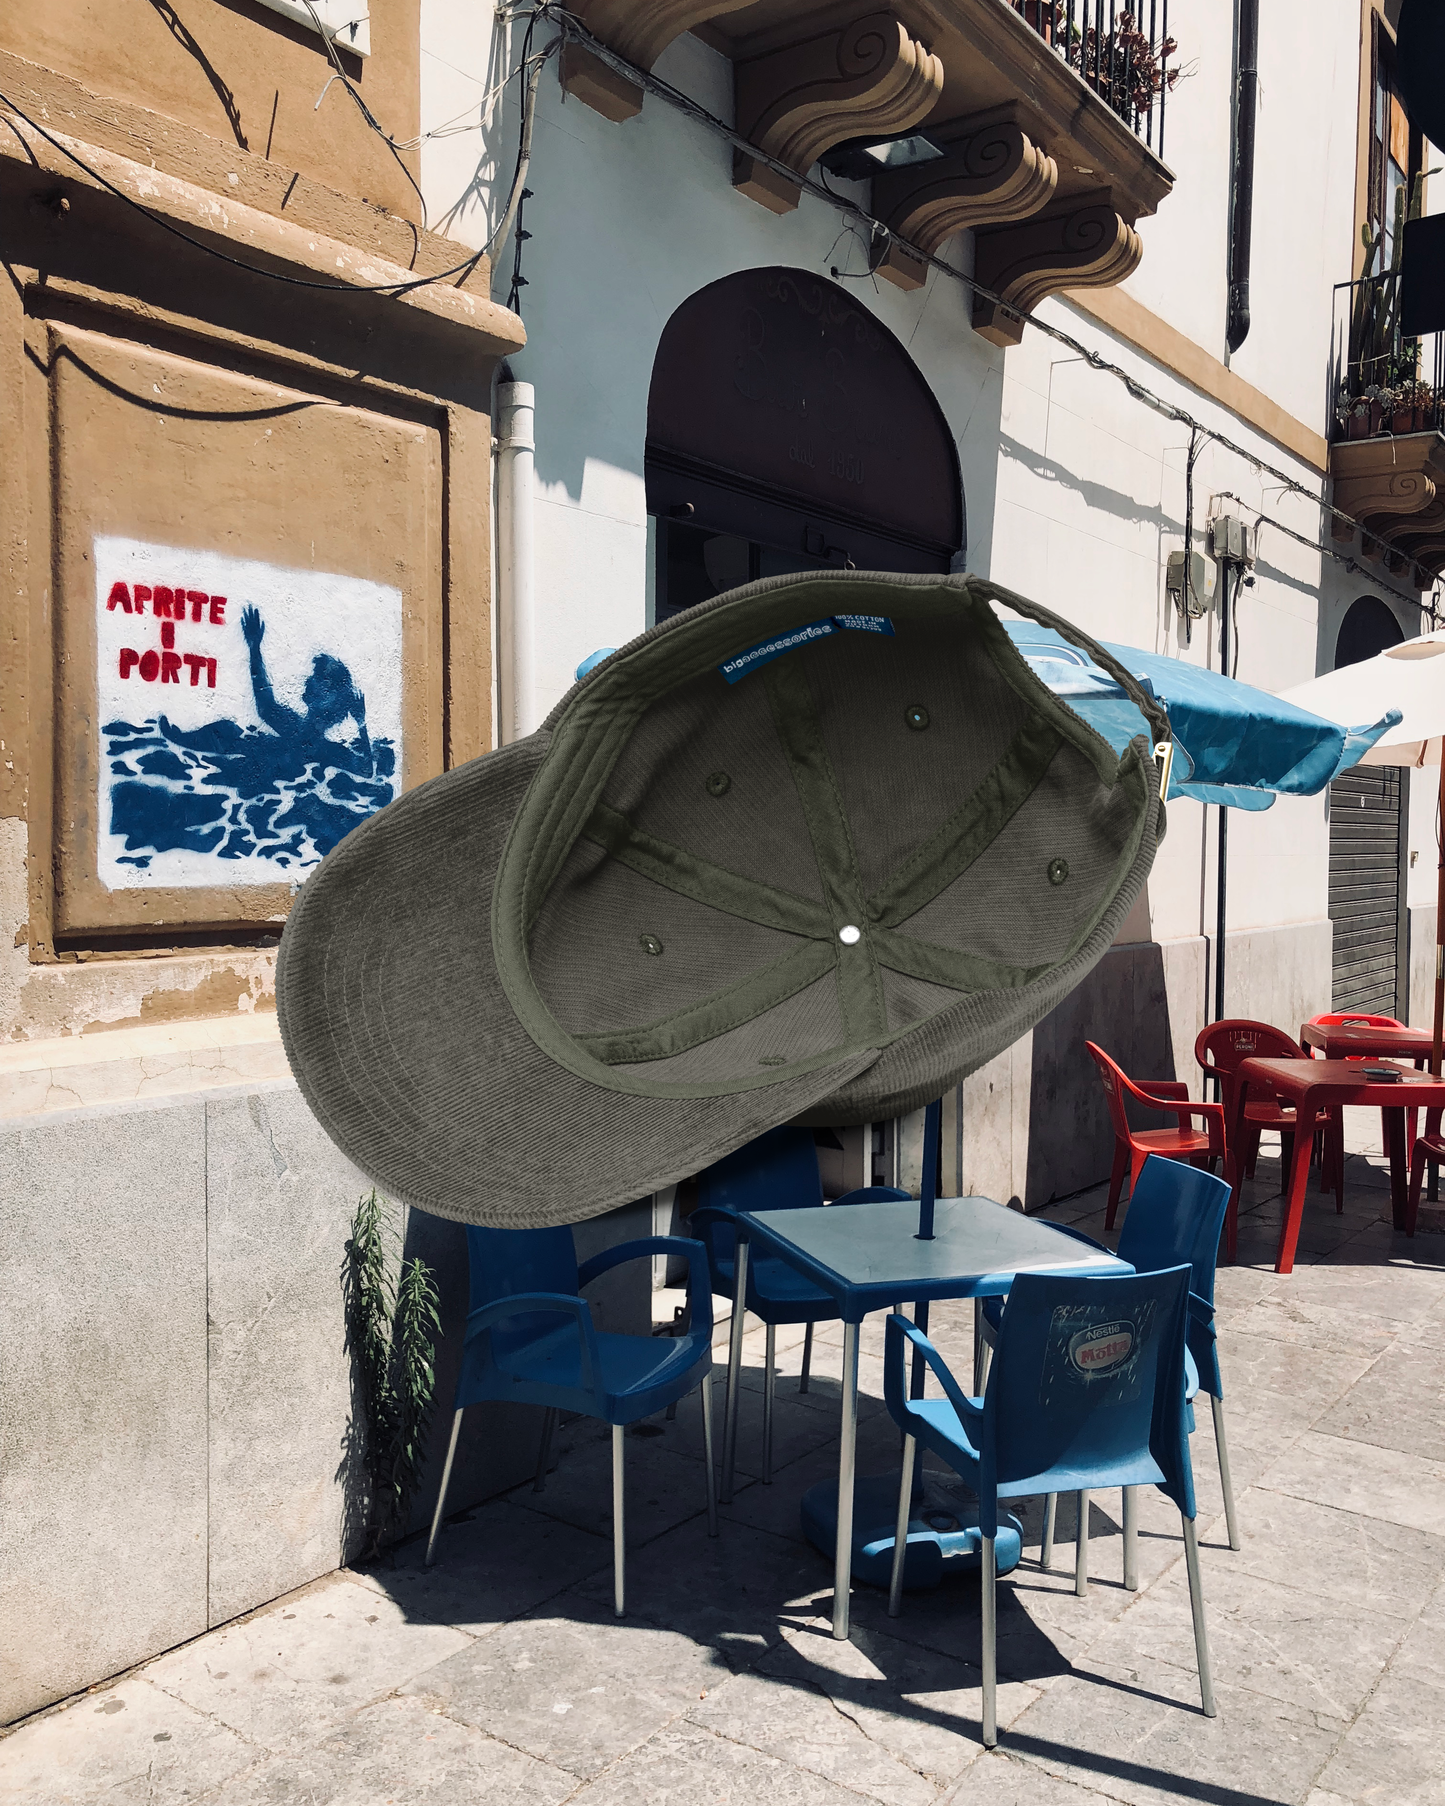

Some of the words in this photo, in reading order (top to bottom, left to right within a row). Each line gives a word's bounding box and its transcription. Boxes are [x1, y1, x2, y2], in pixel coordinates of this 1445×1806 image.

[828, 447, 864, 485] 1950
[106, 582, 228, 625] APRITE
[855, 615, 885, 623] COTTON
[161, 621, 175, 649] I
[723, 624, 832, 673] bigaccessories
[119, 647, 217, 688] PORTI
[1081, 1341, 1128, 1364] Motta
